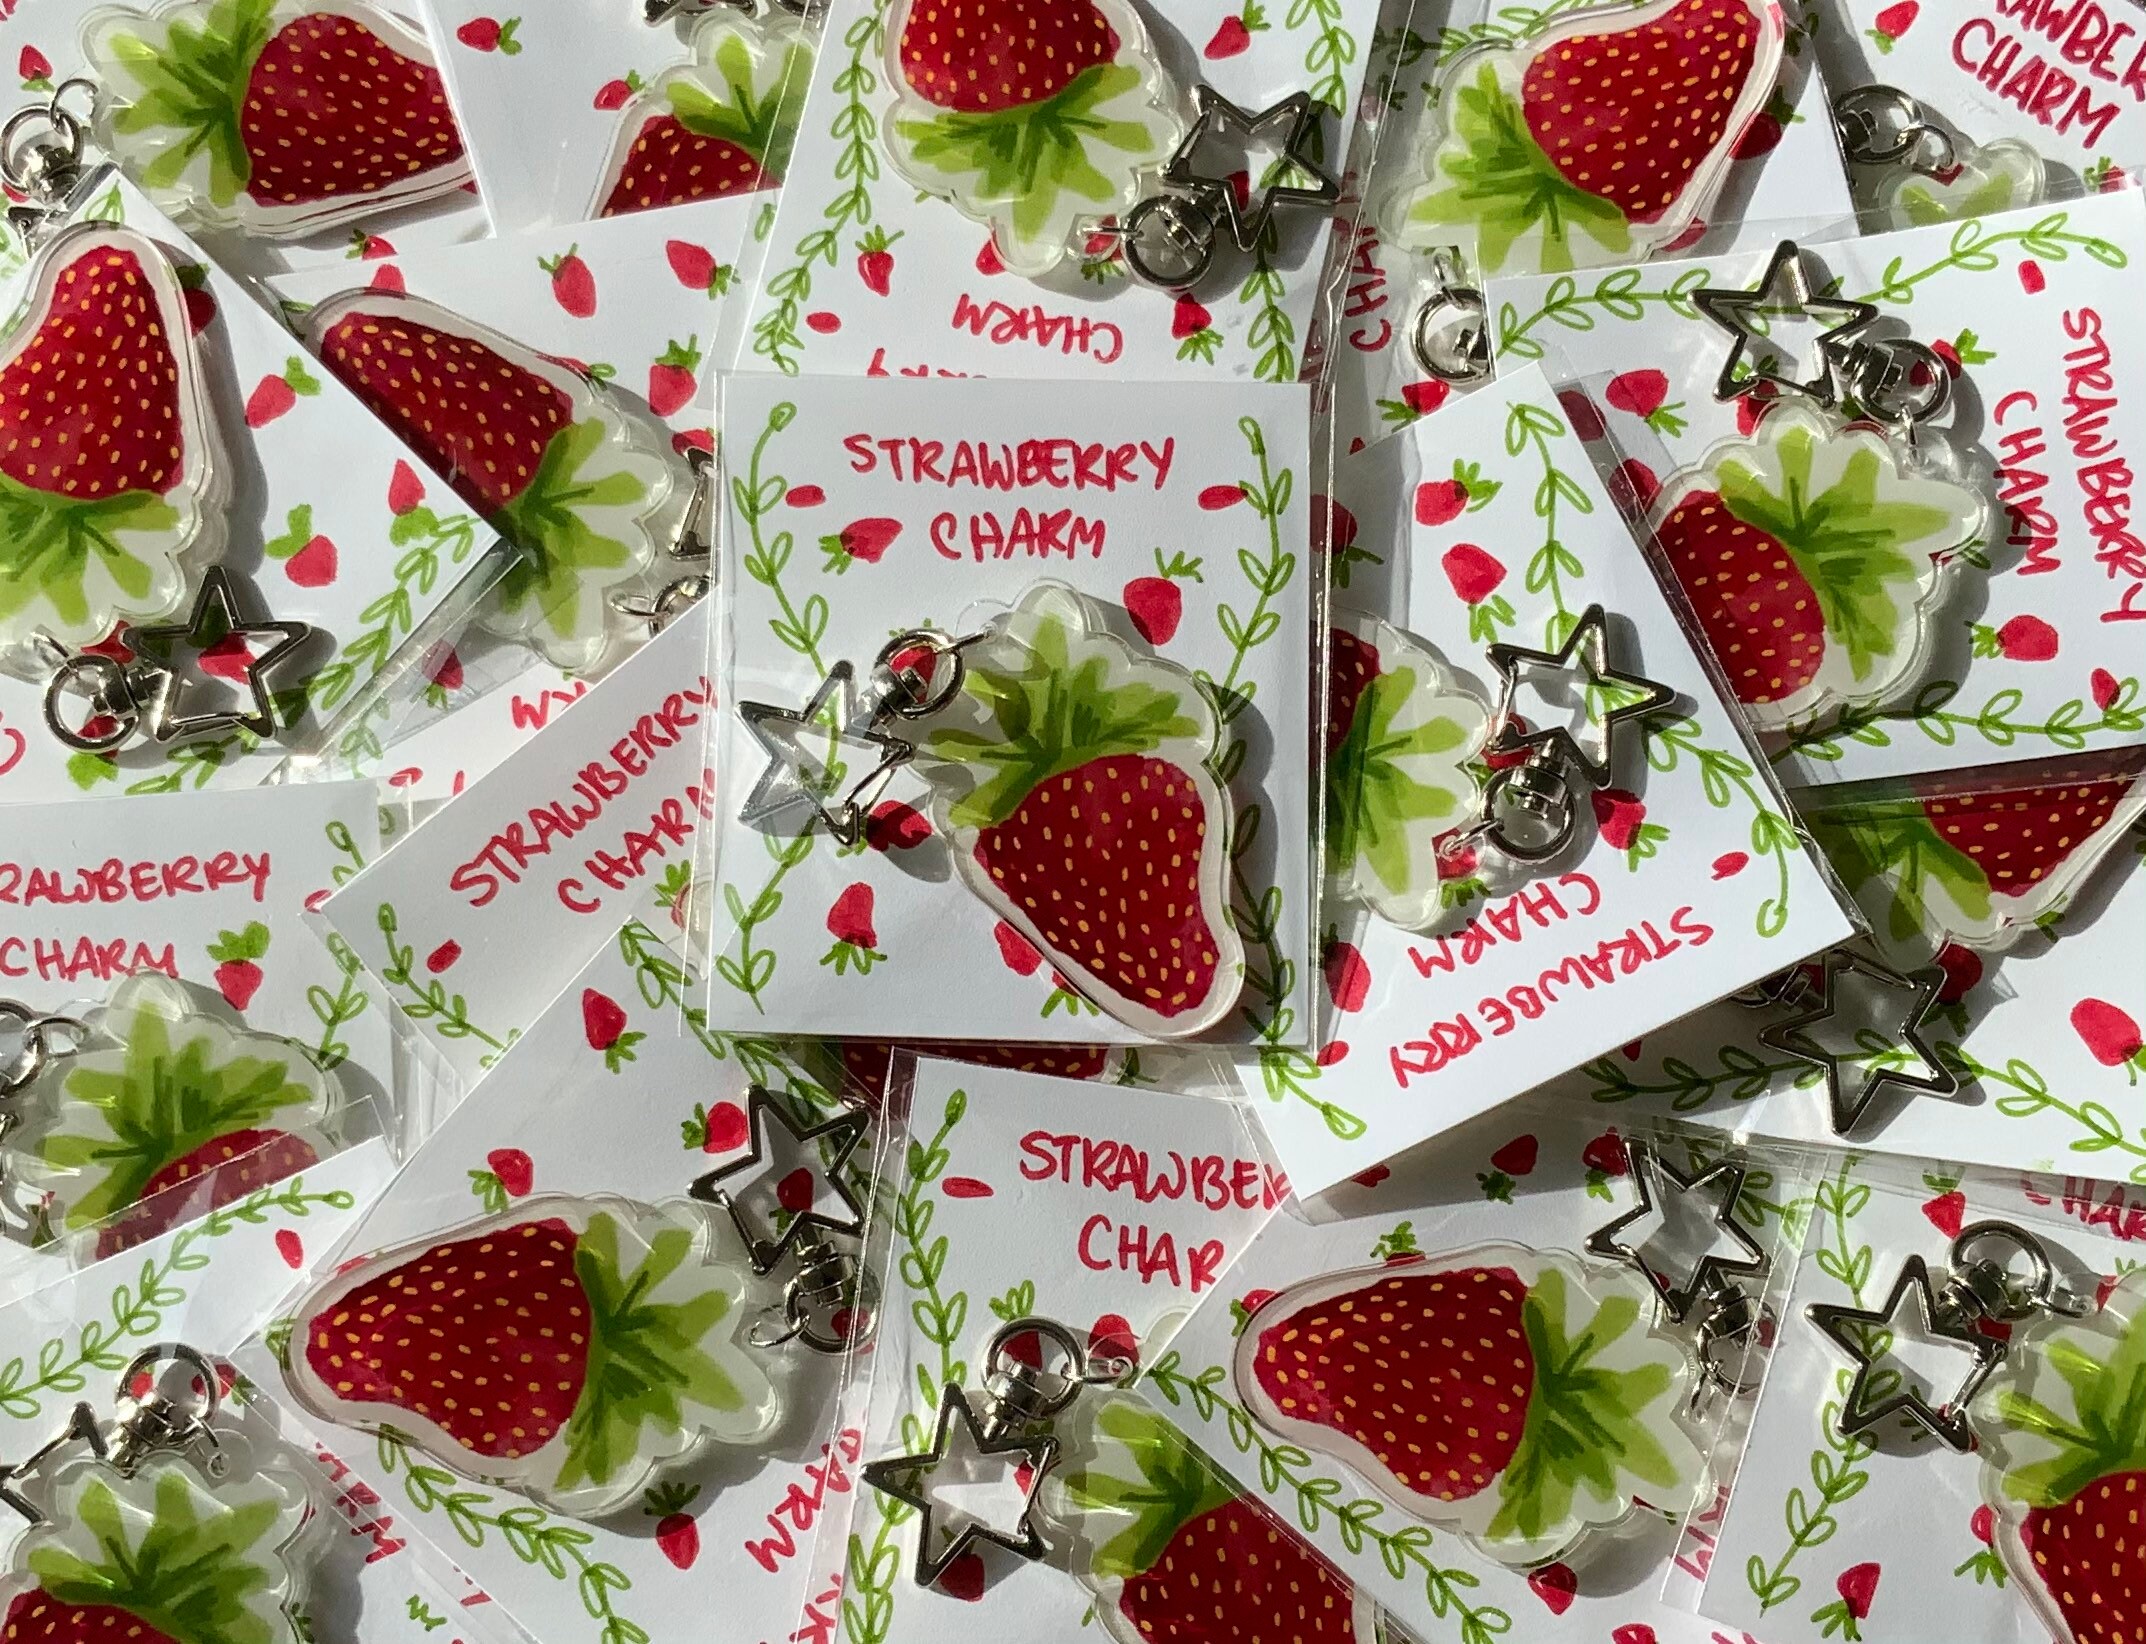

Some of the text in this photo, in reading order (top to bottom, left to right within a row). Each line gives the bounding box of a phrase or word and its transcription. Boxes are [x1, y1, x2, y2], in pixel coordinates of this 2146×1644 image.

[1952, 18, 2121, 149] CHARM
[952, 293, 1124, 364] CHARM
[843, 433, 1175, 492] STRAWBERRY
[1993, 391, 2061, 576] CHARM
[2062, 307, 2146, 623] STRAWBERRY
[930, 507, 1106, 563] CHARM
[0, 936, 179, 983] CHARM
[1407, 872, 1600, 978] CHARM
[1390, 906, 1714, 1088] STRAWBERRY
[1078, 1214, 1225, 1293] CHAR
